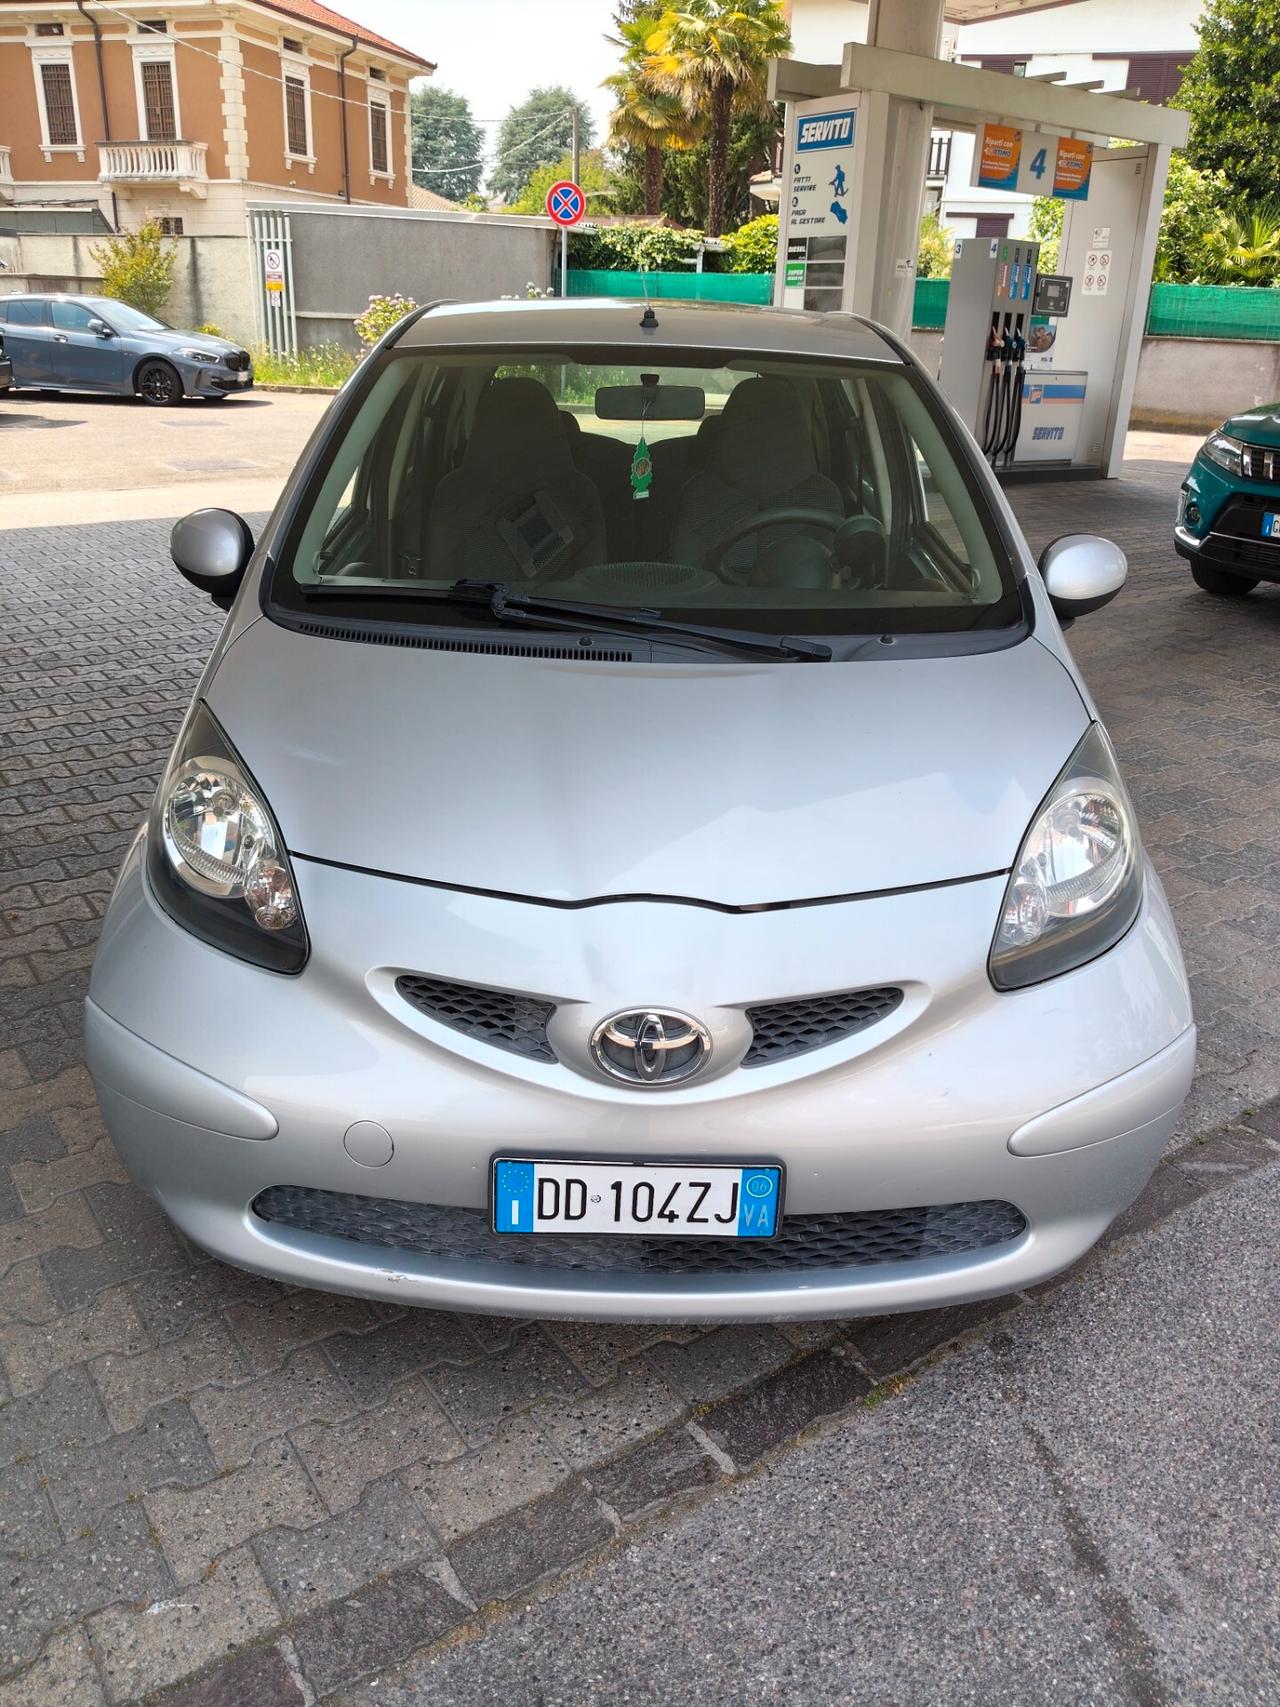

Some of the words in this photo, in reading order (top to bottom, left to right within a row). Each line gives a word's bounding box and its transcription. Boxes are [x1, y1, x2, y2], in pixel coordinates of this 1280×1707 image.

[800, 118, 849, 143] SERVITO
[1029, 148, 1048, 180] 4
[793, 184, 817, 192] SERVIRE
[799, 217, 825, 225] GESTORE
[955, 244, 962, 254] 3
[991, 243, 998, 254] 4
[1032, 427, 1064, 440] SERVITO
[751, 1180, 767, 1192] 06
[537, 1177, 588, 1220] DD
[610, 1180, 740, 1224] 104ZJ
[743, 1204, 770, 1228] VA
